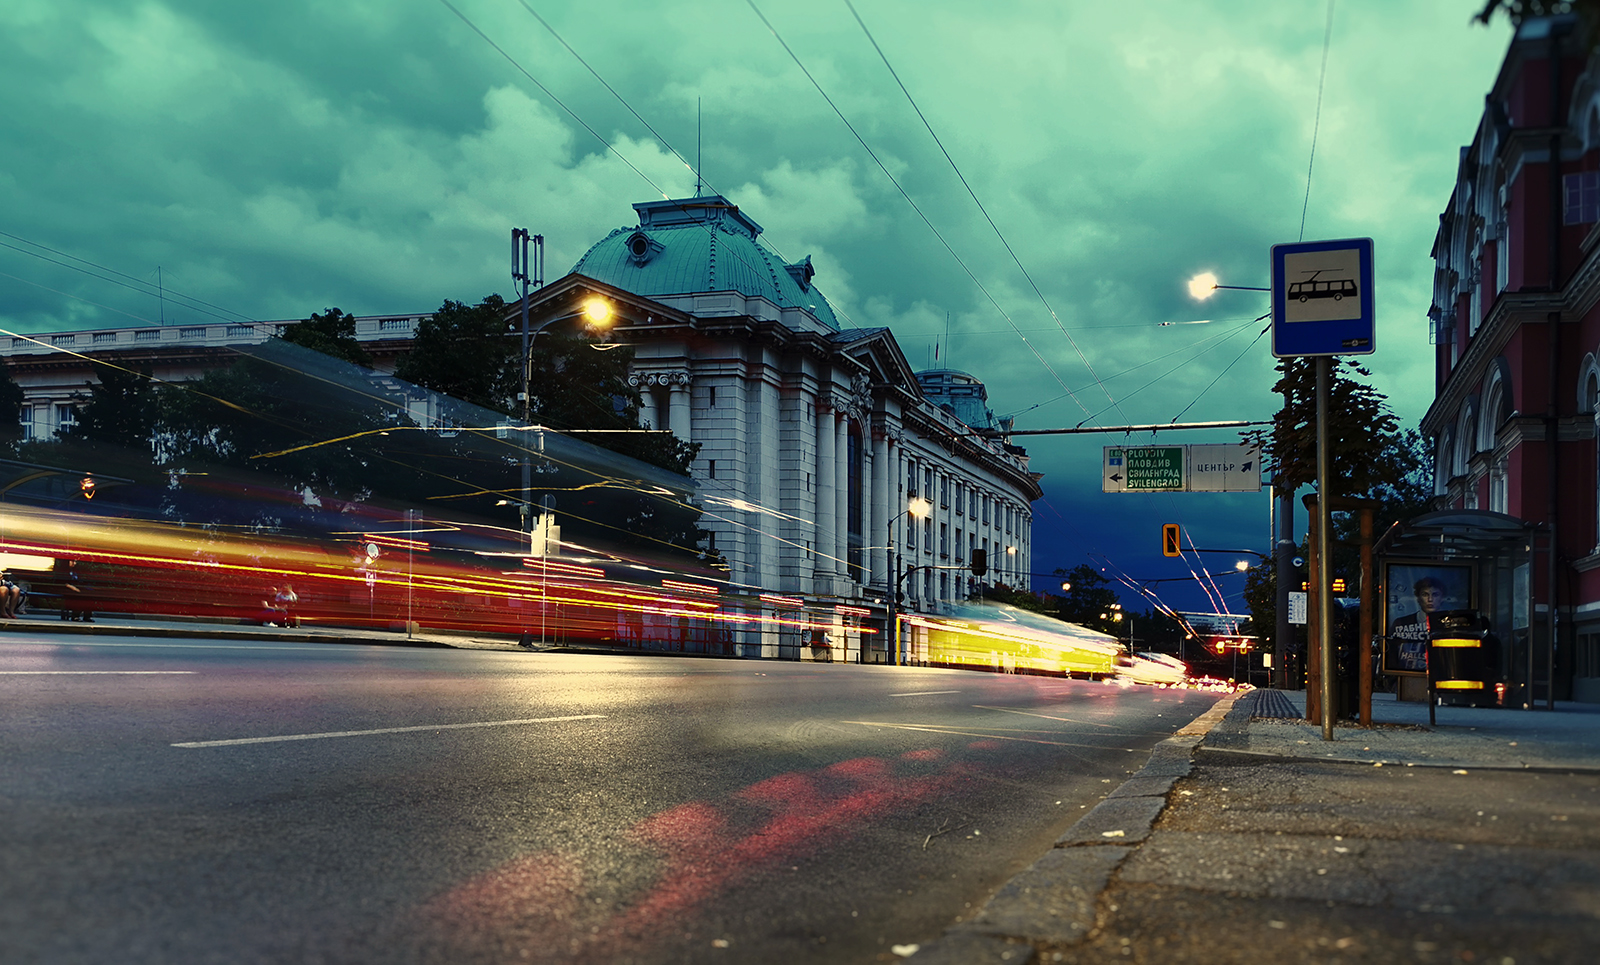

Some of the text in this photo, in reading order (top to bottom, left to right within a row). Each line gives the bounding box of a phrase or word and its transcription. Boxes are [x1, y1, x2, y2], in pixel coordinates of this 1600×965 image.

[1129, 449, 1166, 458] PLOVDIV
[1128, 459, 1171, 468] ПЛОВДИВ
[1197, 463, 1235, 473] ЦЕНТЪР
[1128, 478, 1180, 488] SVILENGRAD
